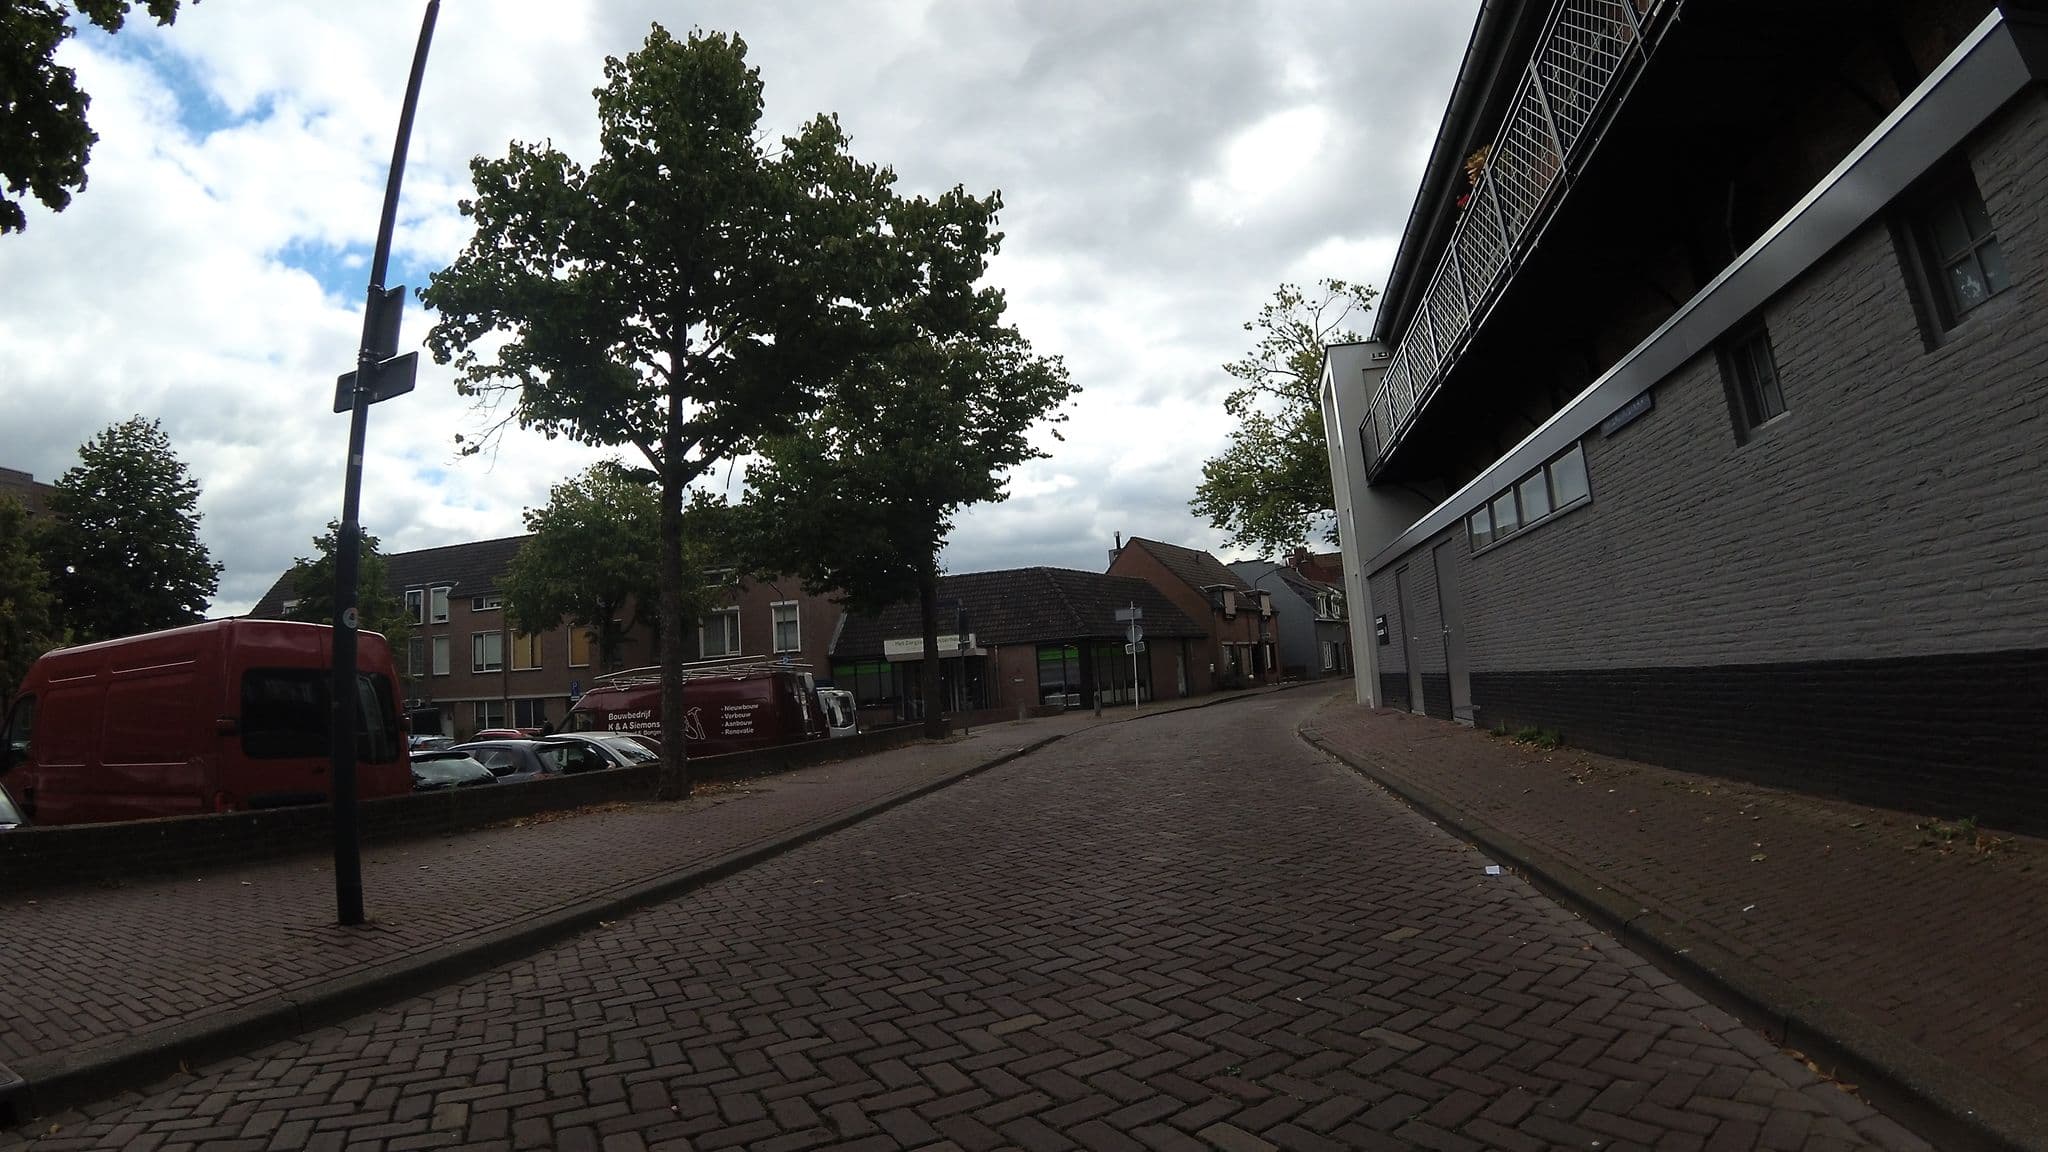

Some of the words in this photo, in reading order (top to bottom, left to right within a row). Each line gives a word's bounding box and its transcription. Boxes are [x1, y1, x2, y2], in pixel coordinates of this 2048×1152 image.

[724, 703, 759, 711] Nieuwbouw
[608, 709, 651, 721] Bouwbedrijf
[608, 723, 614, 731] K
[615, 722, 621, 731] &
[622, 722, 628, 730] A
[629, 721, 661, 730] Siemons
[724, 727, 755, 735] Renovatie
